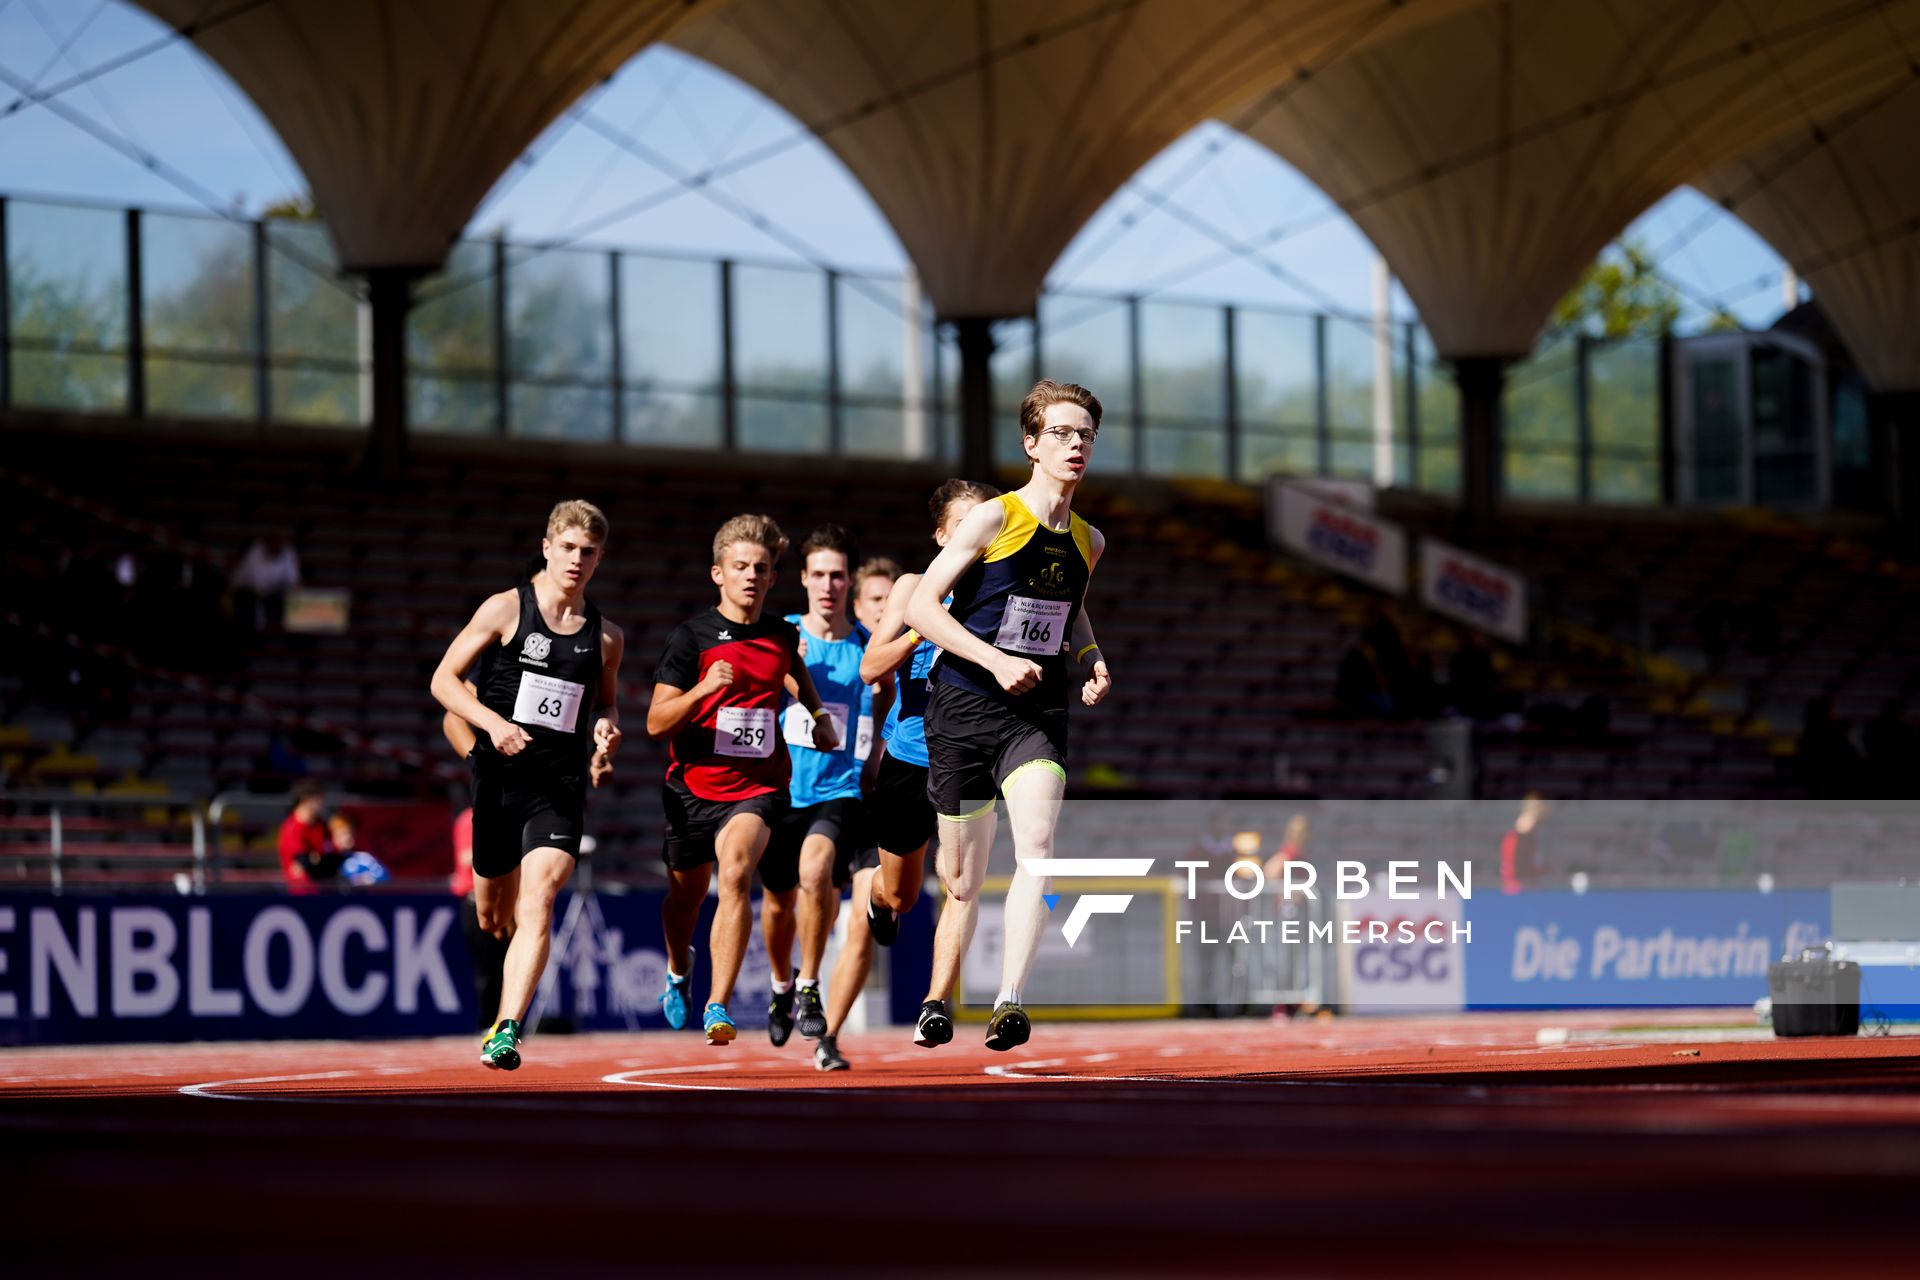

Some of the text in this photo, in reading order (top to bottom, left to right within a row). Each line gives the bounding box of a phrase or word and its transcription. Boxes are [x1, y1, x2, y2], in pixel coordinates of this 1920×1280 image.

[1021, 619, 1051, 642] 166
[538, 697, 562, 718] 63
[731, 727, 766, 746] 259
[1353, 943, 1449, 983] GSG
[1511, 924, 1582, 982] Die
[1590, 922, 1771, 979] Partnerin
